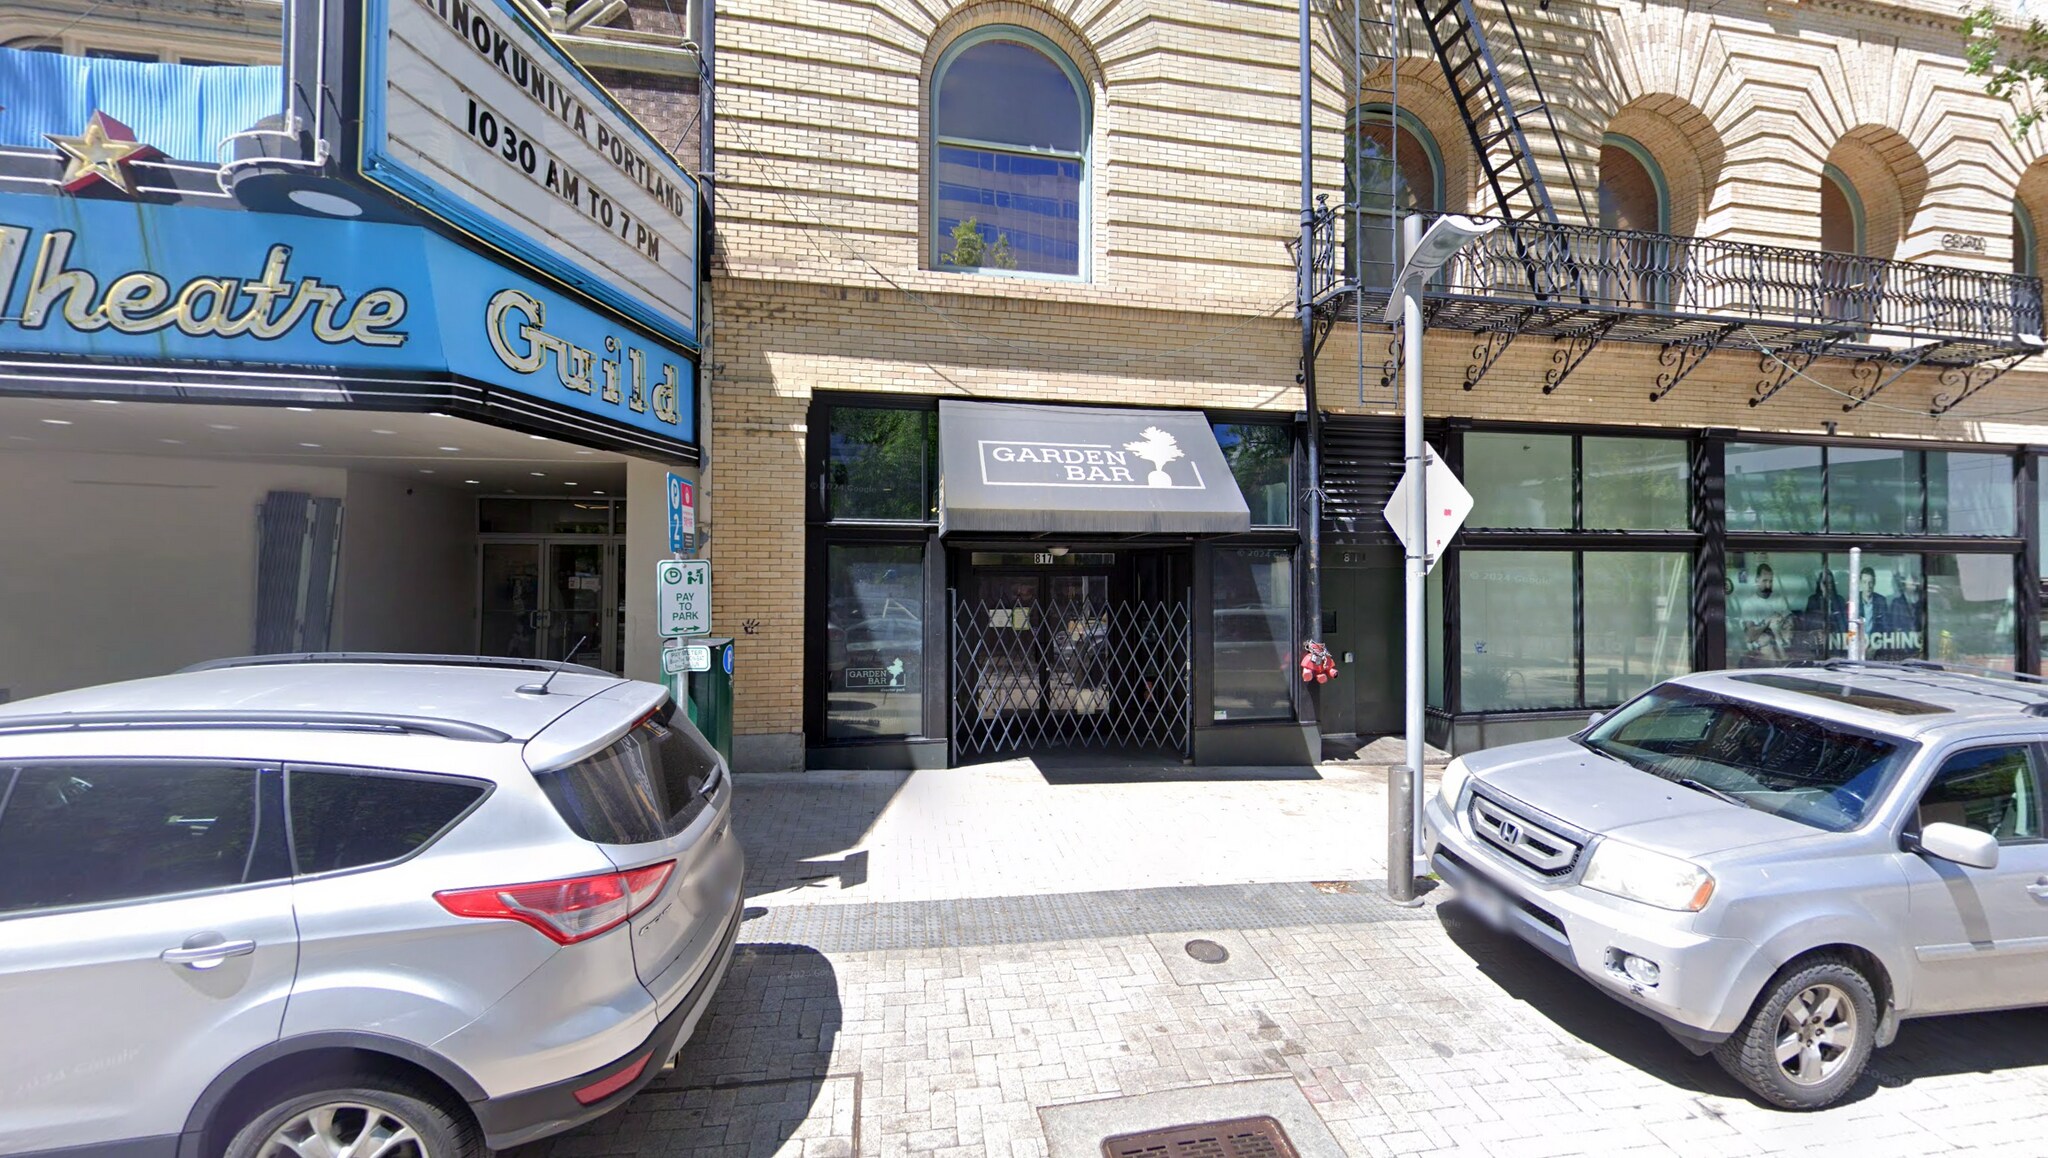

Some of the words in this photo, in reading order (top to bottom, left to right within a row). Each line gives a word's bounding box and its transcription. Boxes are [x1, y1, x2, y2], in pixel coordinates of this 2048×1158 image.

[425, 0, 587, 139] INOKUNIYA
[597, 123, 684, 217] PORTLAND
[546, 159, 579, 207] AM
[588, 187, 613, 228] TO
[620, 211, 630, 239] 7
[636, 223, 659, 262] PM
[485, 288, 681, 425] Guild
[992, 447, 1127, 466] GARDEN
[1064, 465, 1134, 482] BAR
[1035, 553, 1052, 564] 817
[676, 593, 694, 601] PAY
[679, 602, 692, 610] TO
[672, 612, 699, 620] PARK
[1828, 631, 1924, 651] NCHIN
[849, 670, 887, 678] GARDEN
